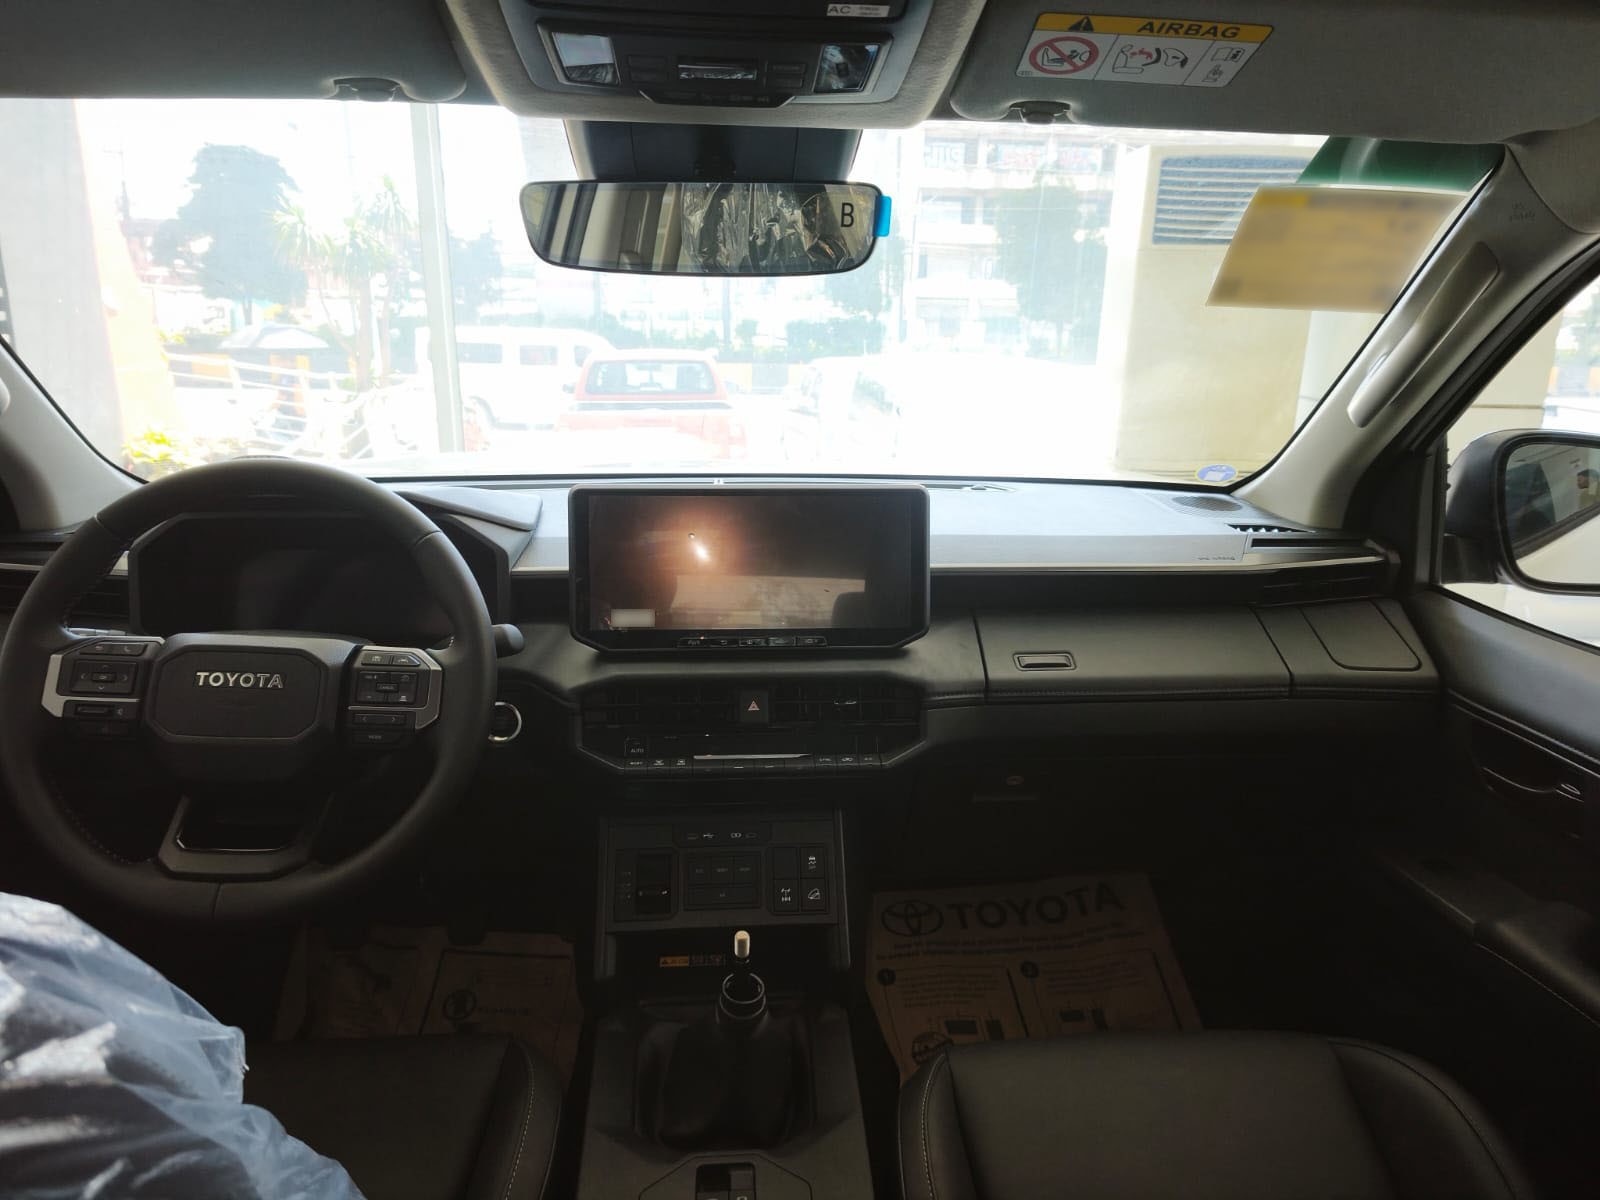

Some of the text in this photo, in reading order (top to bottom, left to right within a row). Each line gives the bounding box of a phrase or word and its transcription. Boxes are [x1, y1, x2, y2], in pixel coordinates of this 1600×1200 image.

[828, 5, 851, 14] AC
[1137, 21, 1241, 39] AIRBAG
[841, 202, 854, 227] B
[196, 671, 284, 689] TOYOTA
[946, 881, 1126, 930] TOYOTA
